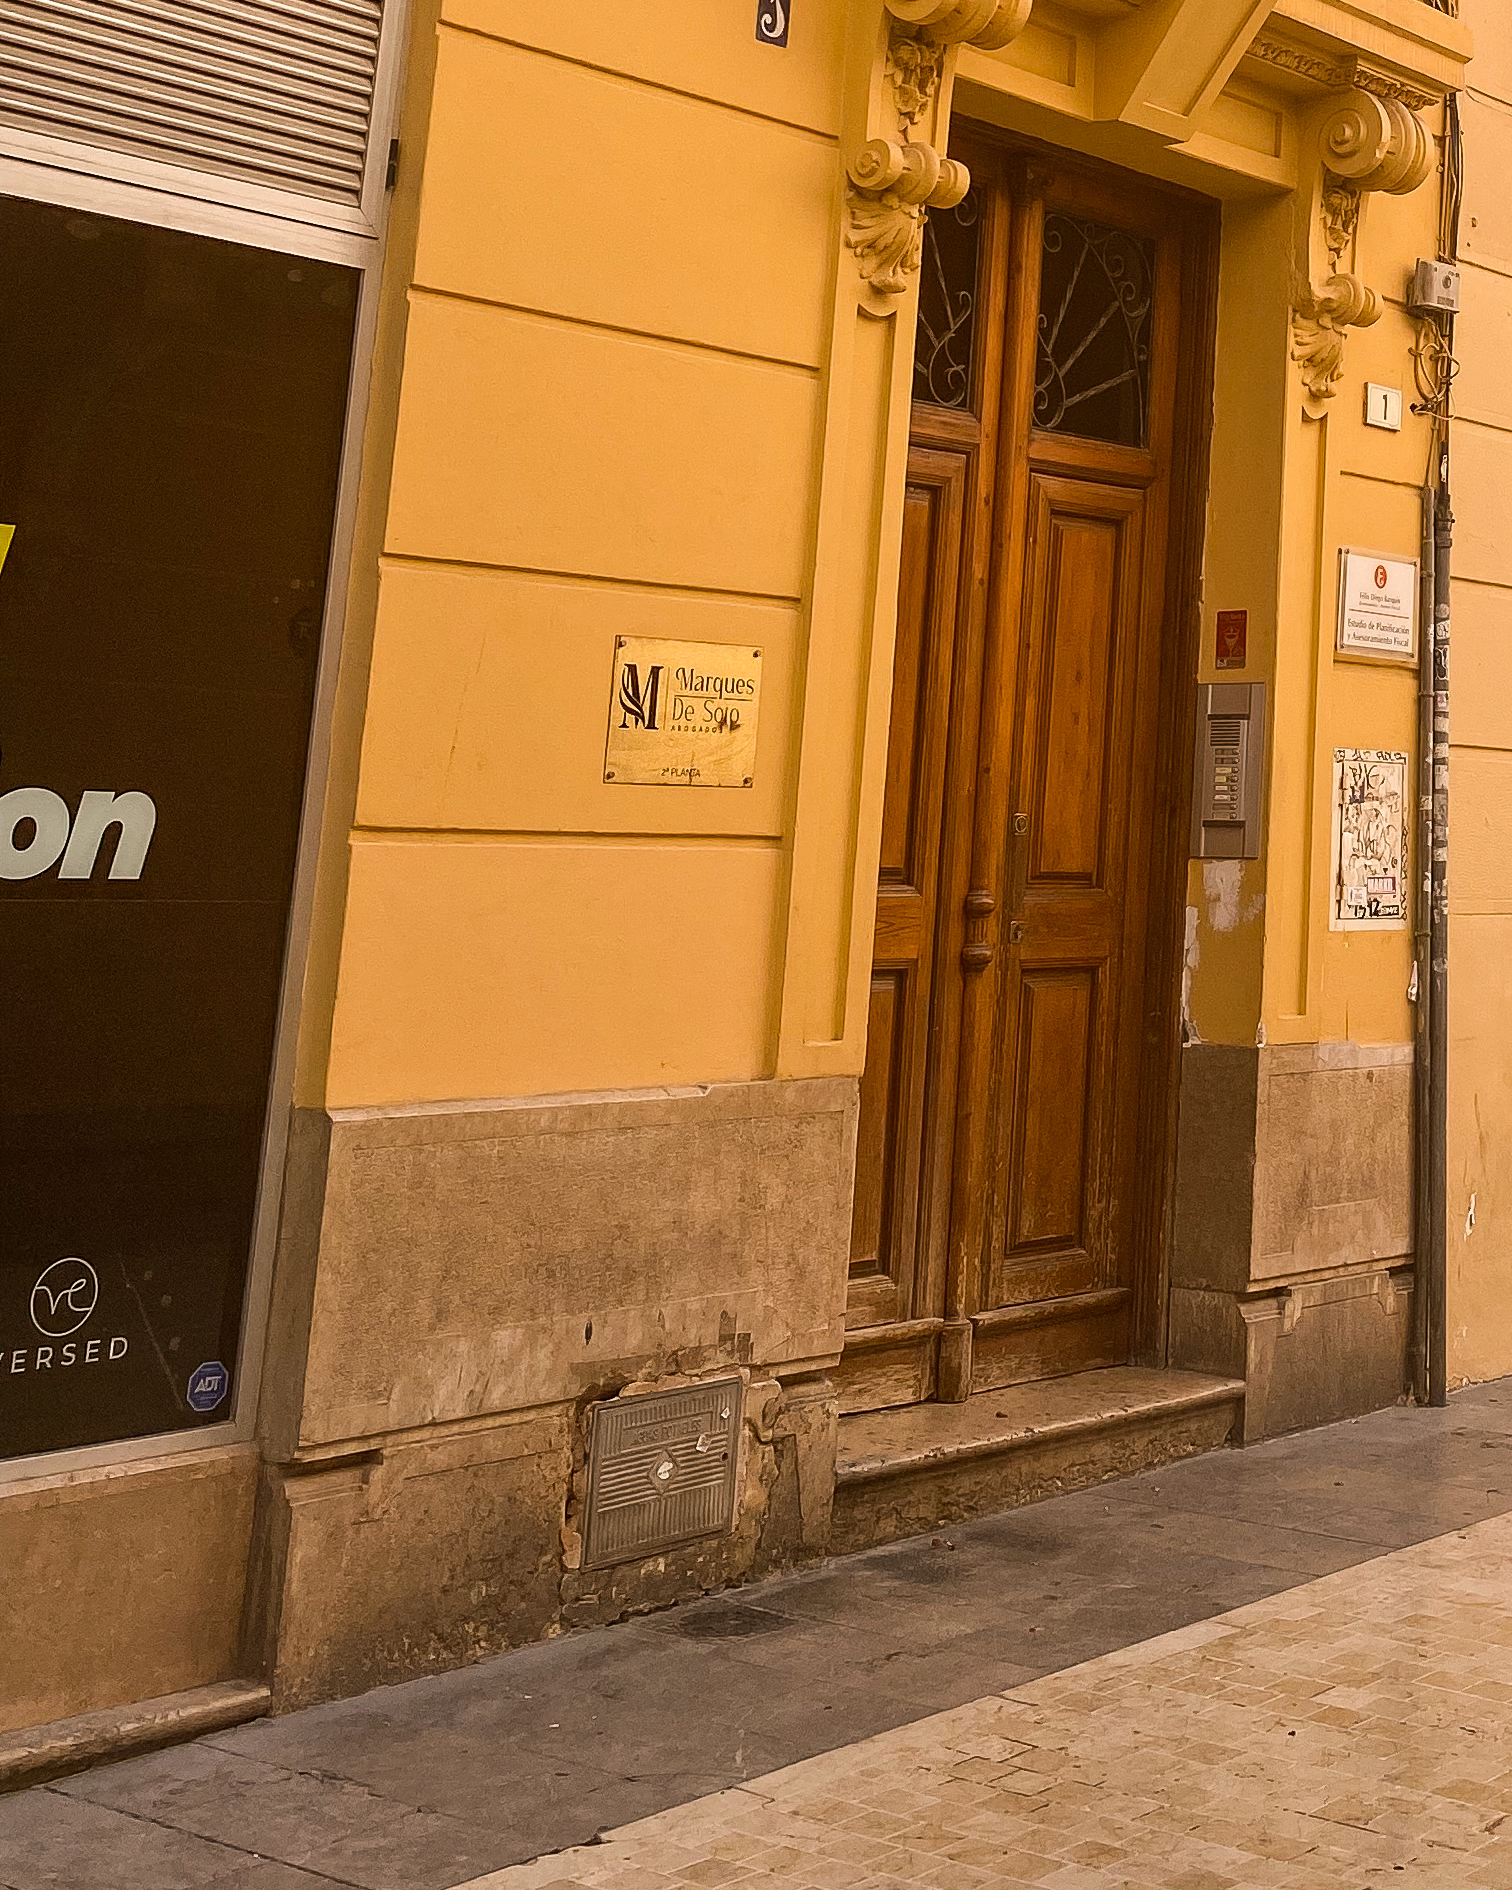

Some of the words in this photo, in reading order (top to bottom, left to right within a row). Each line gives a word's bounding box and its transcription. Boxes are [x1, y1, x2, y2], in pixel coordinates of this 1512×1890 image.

[1382, 393, 1388, 420] 1
[1348, 617, 1367, 629] Estudio
[1368, 620, 1375, 630] de
[675, 667, 755, 700] Marques
[672, 697, 695, 722] De
[0, 1336, 130, 1375] ERSED
[194, 1376, 222, 1394] ADT
